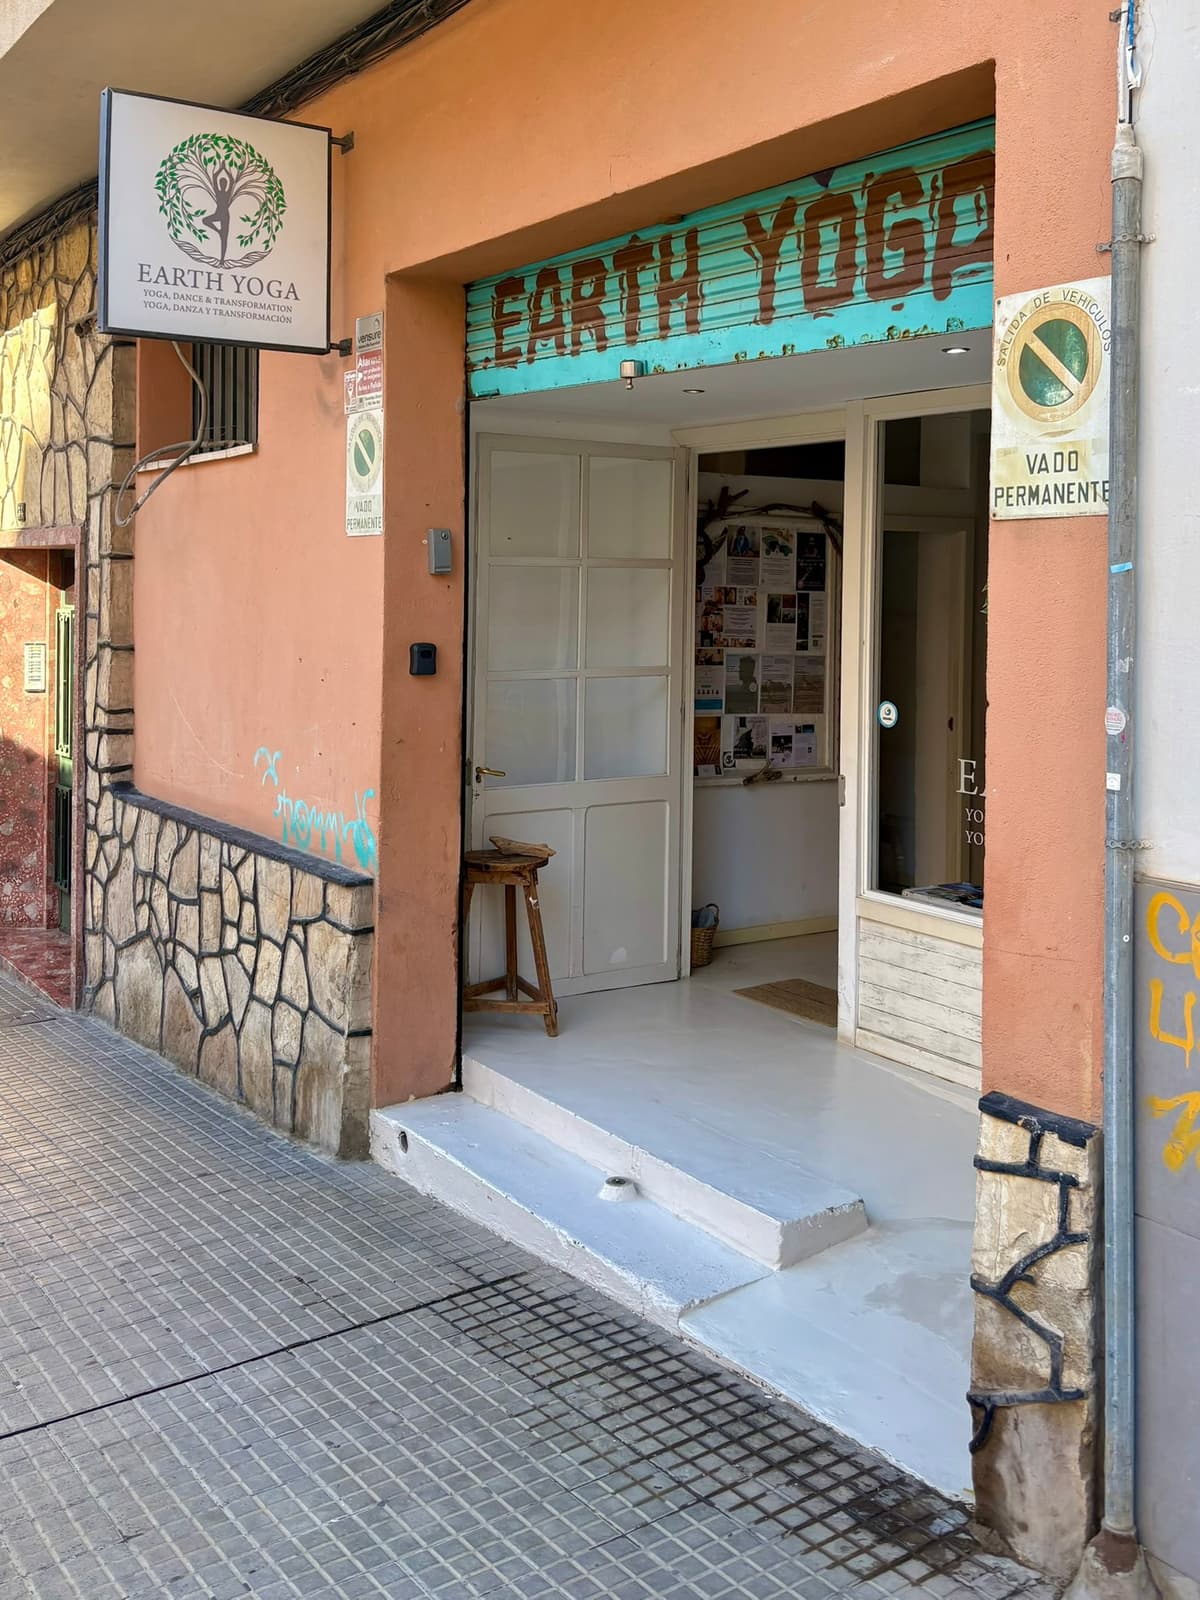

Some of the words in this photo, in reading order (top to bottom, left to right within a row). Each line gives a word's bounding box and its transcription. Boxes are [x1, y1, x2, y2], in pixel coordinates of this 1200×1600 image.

[137, 263, 224, 292] EARTH
[231, 275, 301, 301] YOGA
[143, 289, 171, 300] YOGA,
[173, 292, 203, 303] DANCE
[214, 297, 293, 313] TRANSFORMATION
[491, 227, 702, 368] EARTH
[143, 300, 171, 311] YOGA,
[173, 304, 203, 314] DANZA
[205, 307, 211, 315] Y
[214, 309, 293, 324] TRANSFORMACIÓN
[997, 311, 1027, 368] SALIDA
[1033, 291, 1051, 309] DE
[1062, 289, 1112, 353] VEHICULOS
[1026, 450, 1079, 475] VADO
[353, 499, 372, 513] VADO
[994, 480, 1109, 508] PERMANENTE
[347, 516, 382, 530] PERMANENTE
[955, 758, 986, 797] E
